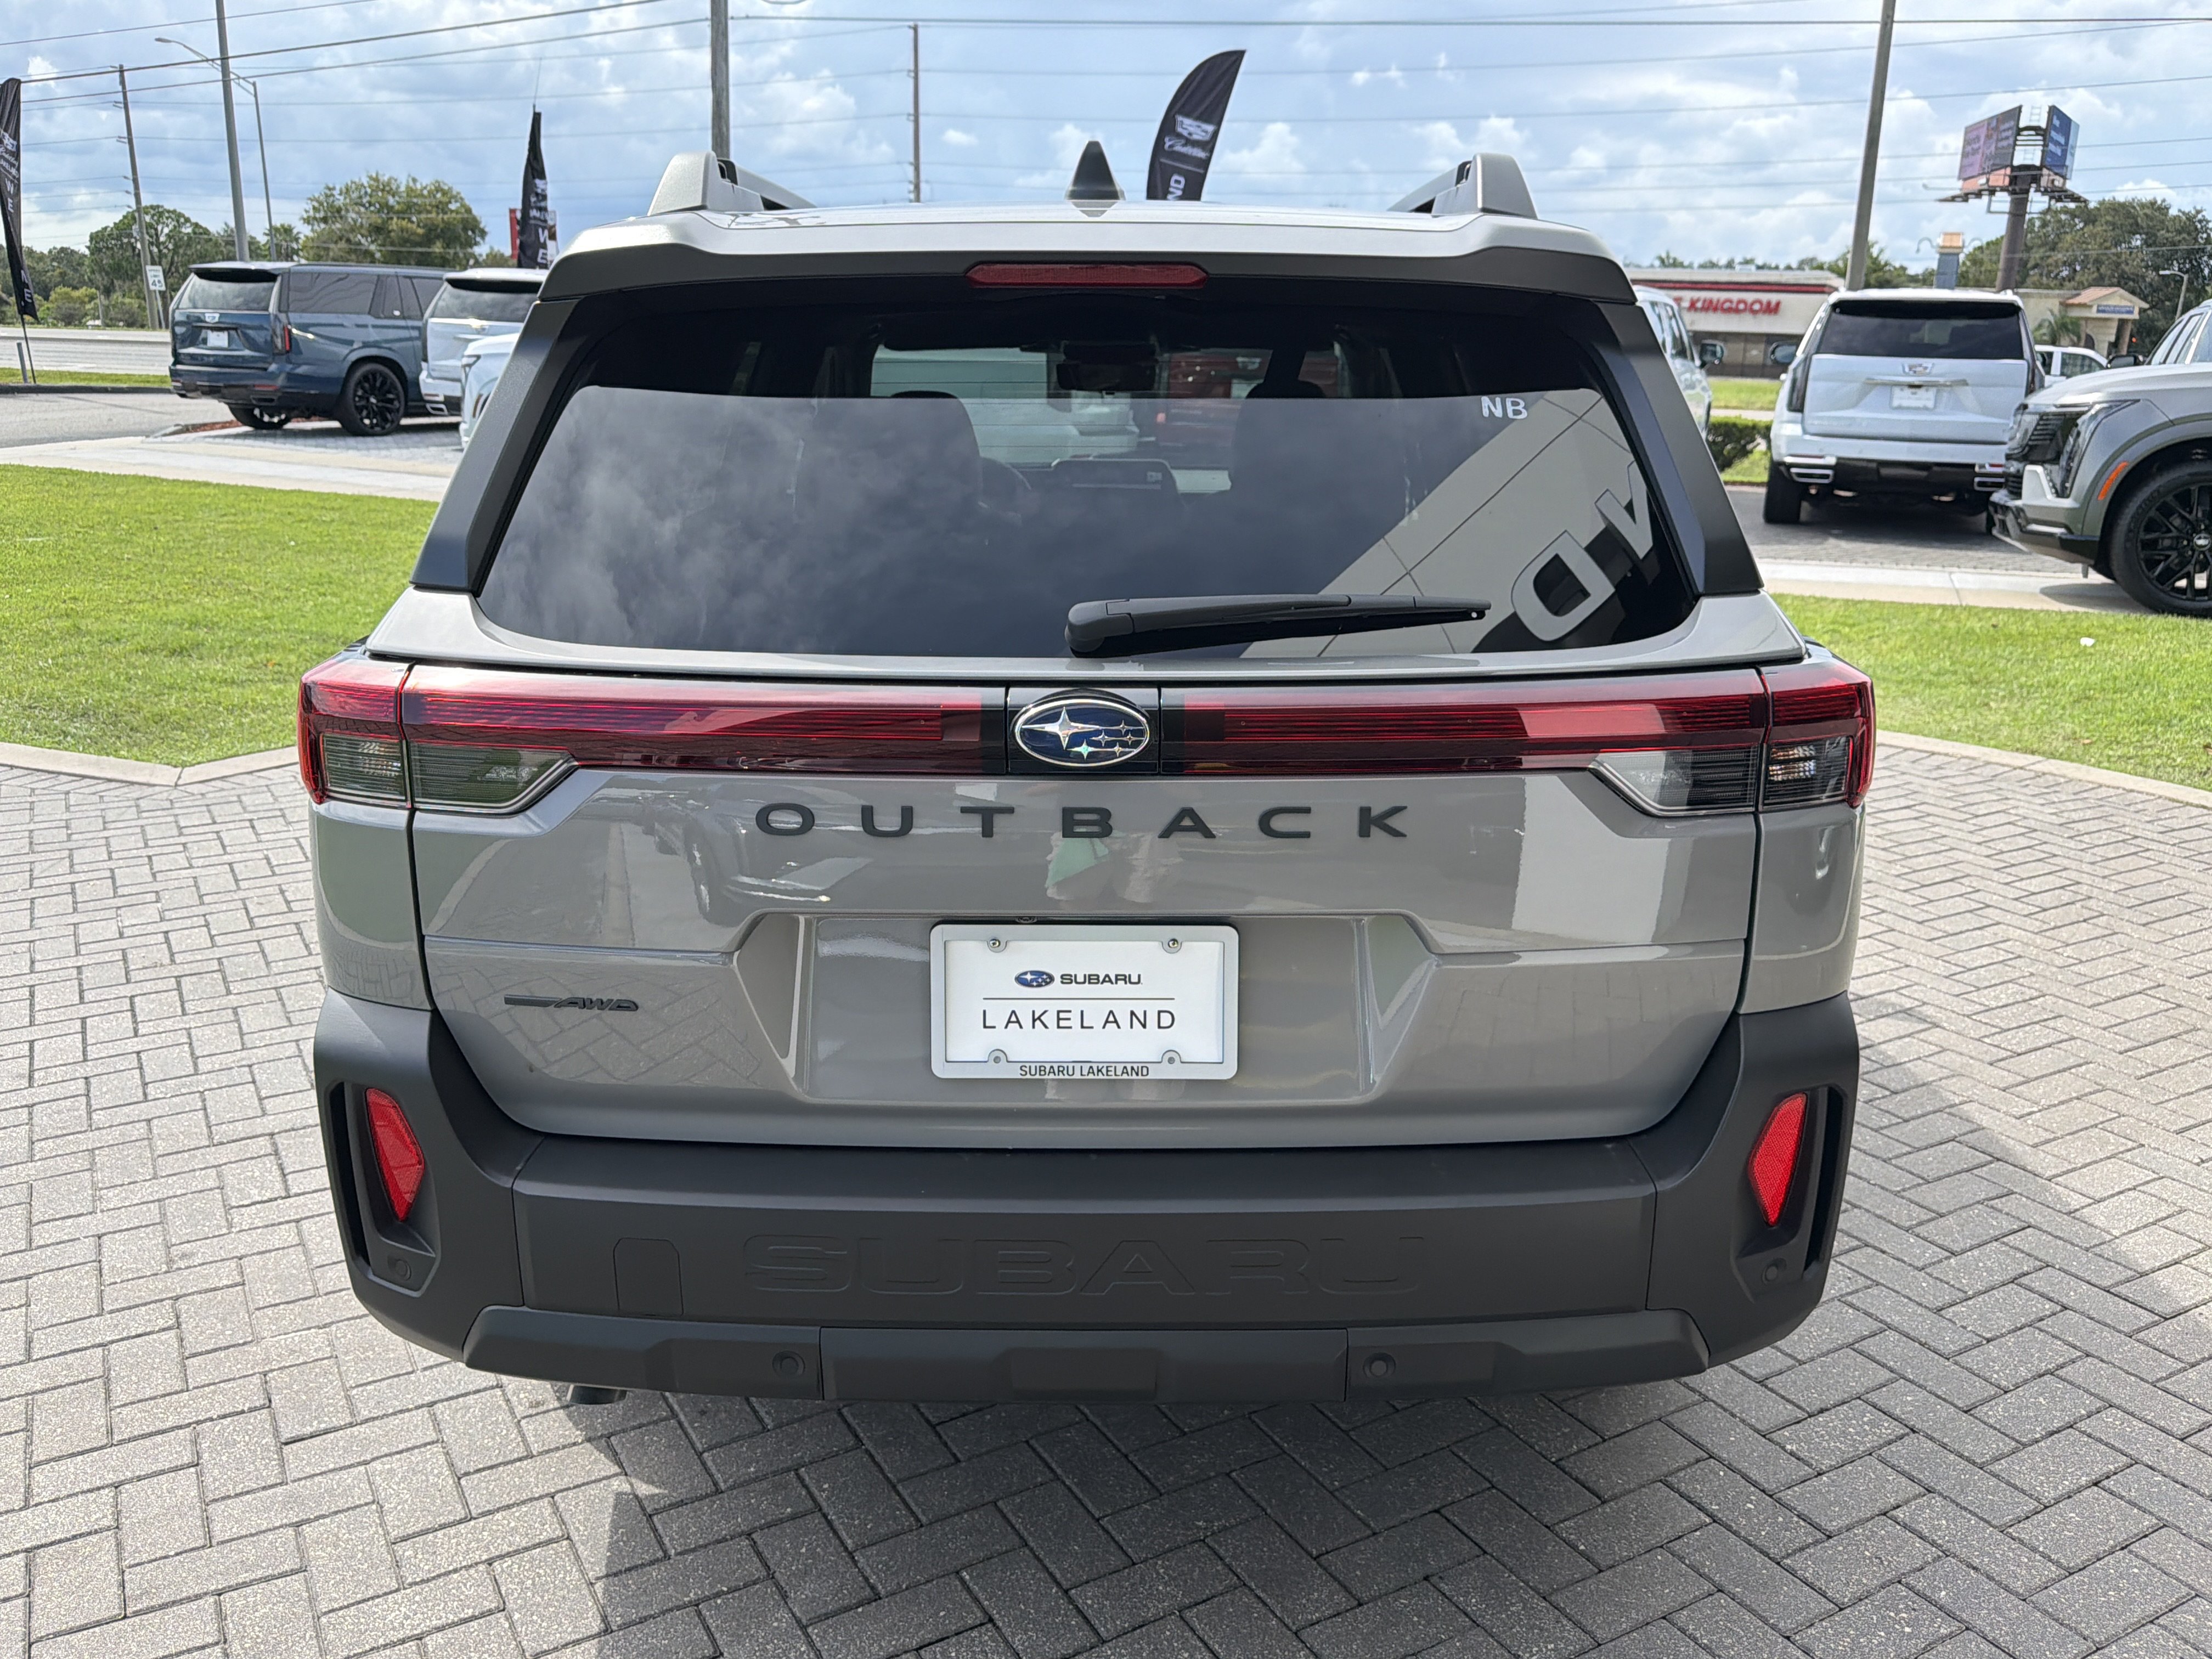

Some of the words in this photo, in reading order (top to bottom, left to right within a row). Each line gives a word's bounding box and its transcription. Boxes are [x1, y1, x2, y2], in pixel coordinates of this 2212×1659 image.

[1687, 296, 1781, 315] KINGDOM
[1481, 396, 1528, 419] NB
[755, 803, 1408, 839] OUTBACK
[1060, 973, 1141, 985] SUBARU
[554, 997, 639, 1012] AWD
[982, 1009, 1176, 1030] LAKELAND
[1019, 1065, 1075, 1077] SUBARU
[1079, 1065, 1150, 1077] LAKELAND
[743, 1235, 1424, 1295] SUBARU
